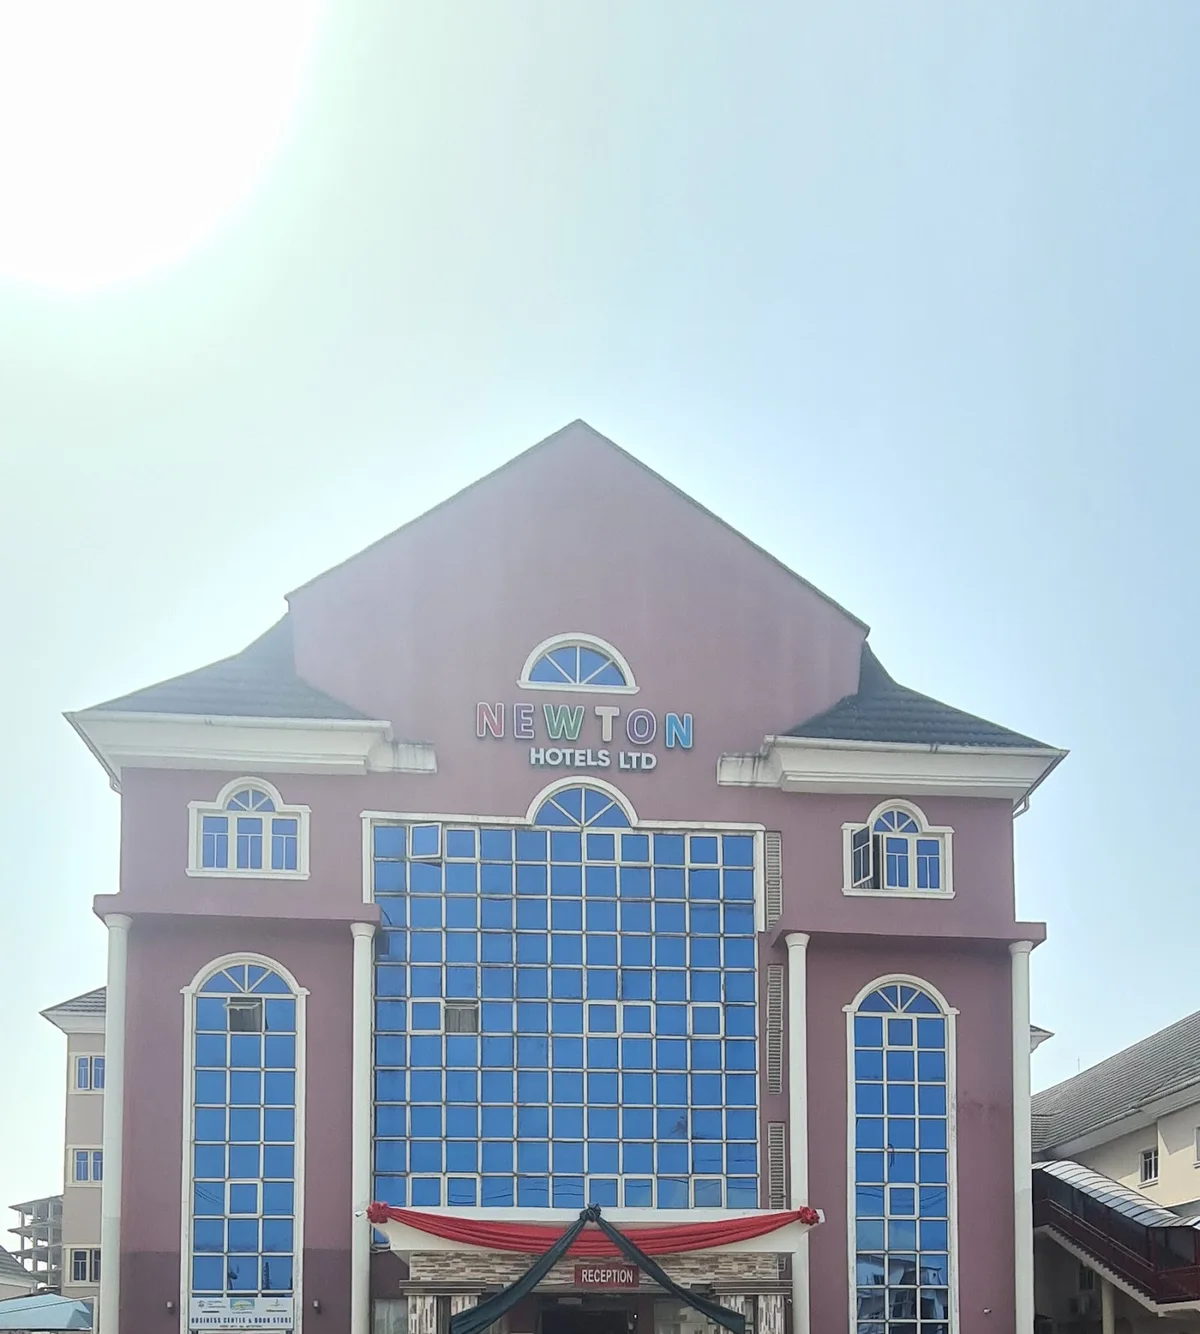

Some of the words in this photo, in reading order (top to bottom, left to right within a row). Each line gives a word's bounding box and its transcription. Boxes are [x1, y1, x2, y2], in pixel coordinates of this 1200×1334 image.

[476, 702, 693, 748] NEWTON
[530, 747, 611, 767] HOTELS
[619, 751, 657, 769] LTD
[581, 1269, 633, 1283] RECEPTION
